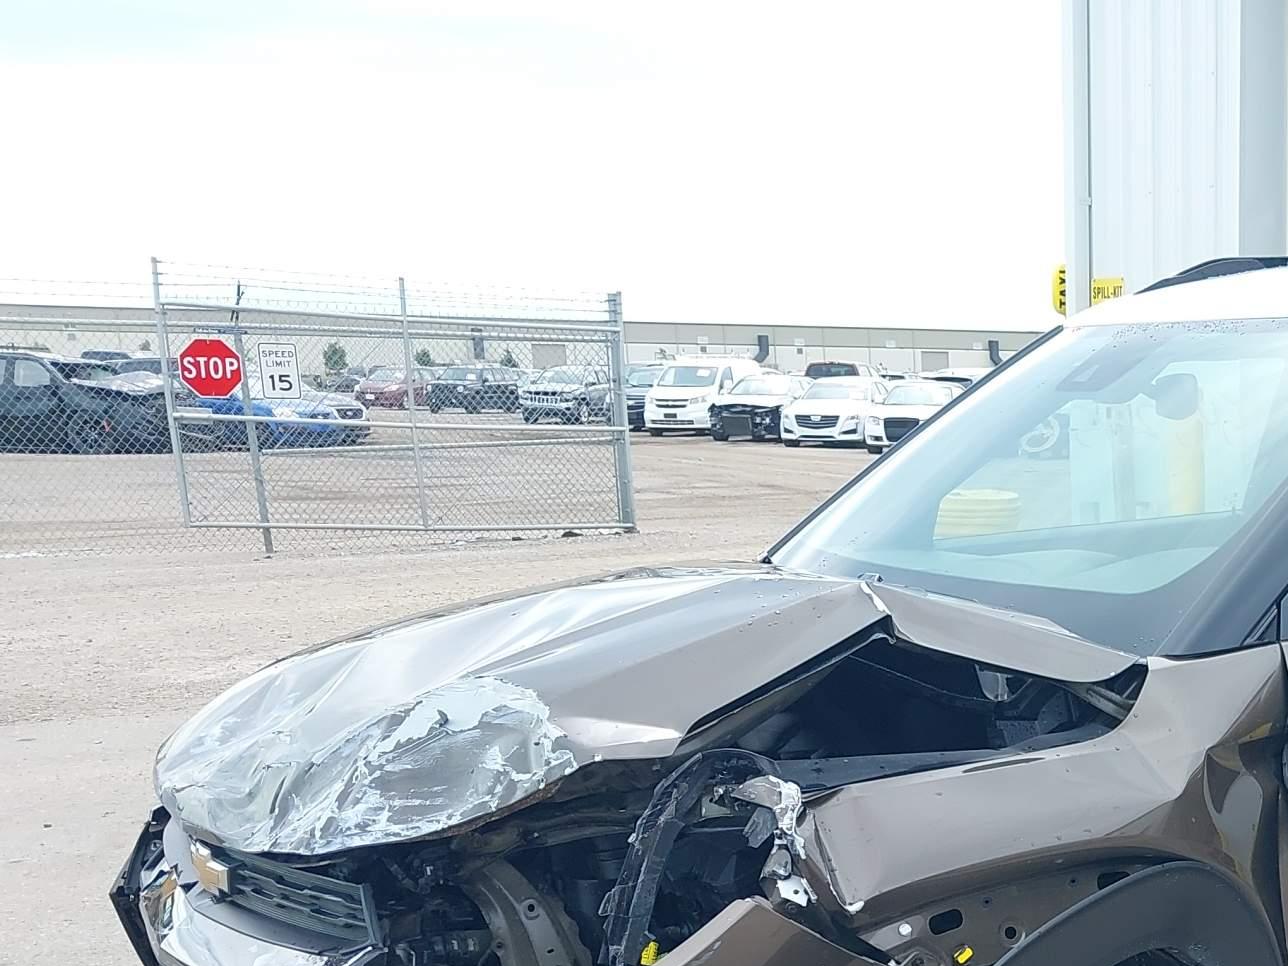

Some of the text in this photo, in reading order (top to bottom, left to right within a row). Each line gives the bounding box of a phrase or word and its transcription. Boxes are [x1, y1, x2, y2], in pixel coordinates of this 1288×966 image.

[261, 350, 294, 358] SPEED
[182, 356, 239, 380] STOP
[265, 359, 292, 368] LIMIT
[268, 374, 293, 392] 15
